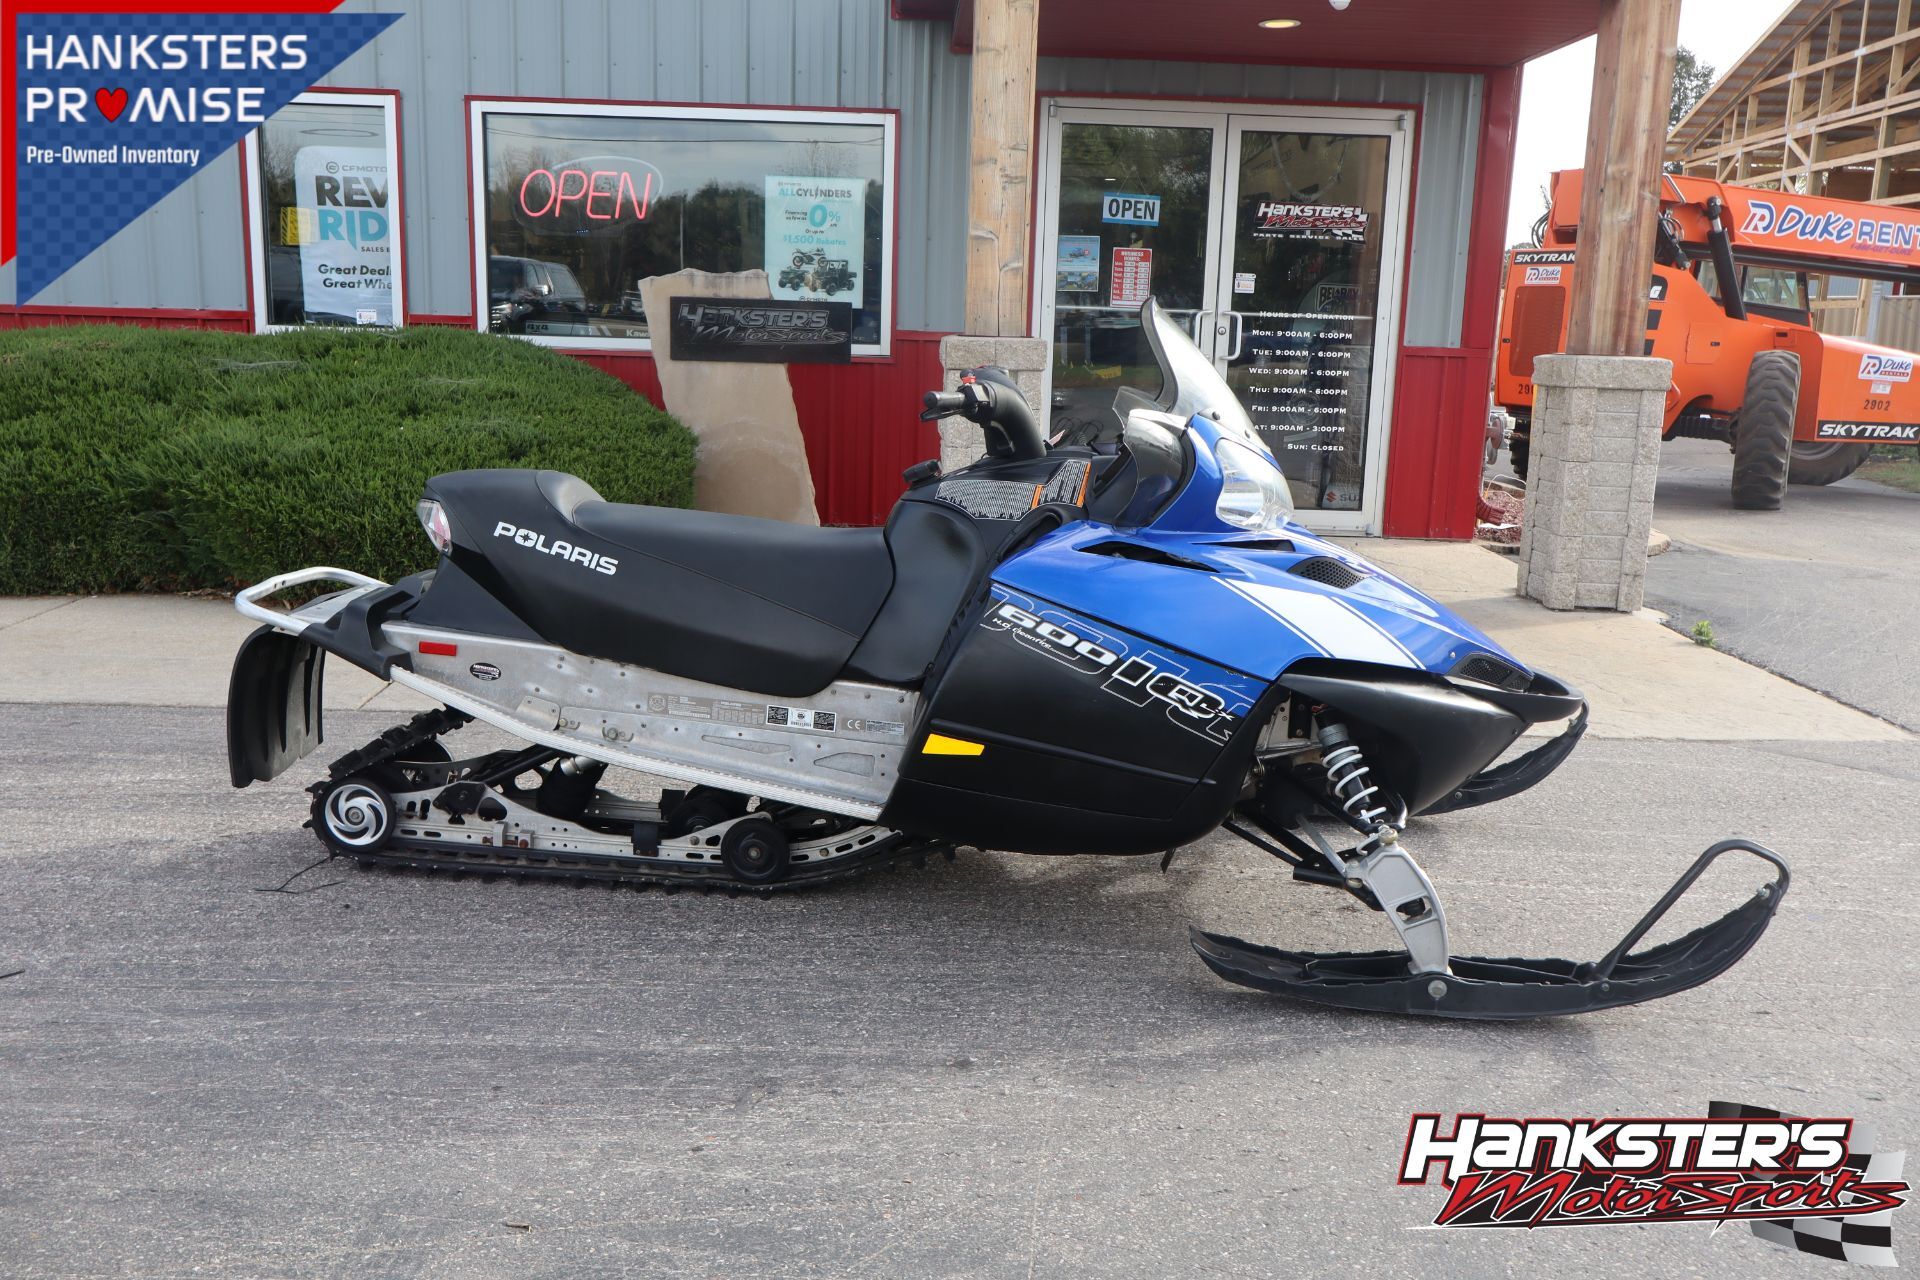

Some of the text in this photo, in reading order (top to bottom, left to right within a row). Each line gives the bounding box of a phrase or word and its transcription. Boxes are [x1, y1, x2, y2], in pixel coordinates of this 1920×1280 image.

[315, 175, 389, 208] REV
[520, 169, 652, 220] OPEN
[1108, 198, 1156, 220] OPEN
[318, 264, 392, 276] Great Deal
[323, 278, 362, 289] Great
[1276, 330, 1310, 338] 9:00AM
[1320, 332, 1352, 340] 6:00PM
[1274, 368, 1308, 376] 9:00AM
[1864, 400, 1890, 410] 2902
[1820, 424, 1918, 438] SKYTRAK
[494, 521, 618, 576] POLARIS
[998, 603, 1119, 667] 600
